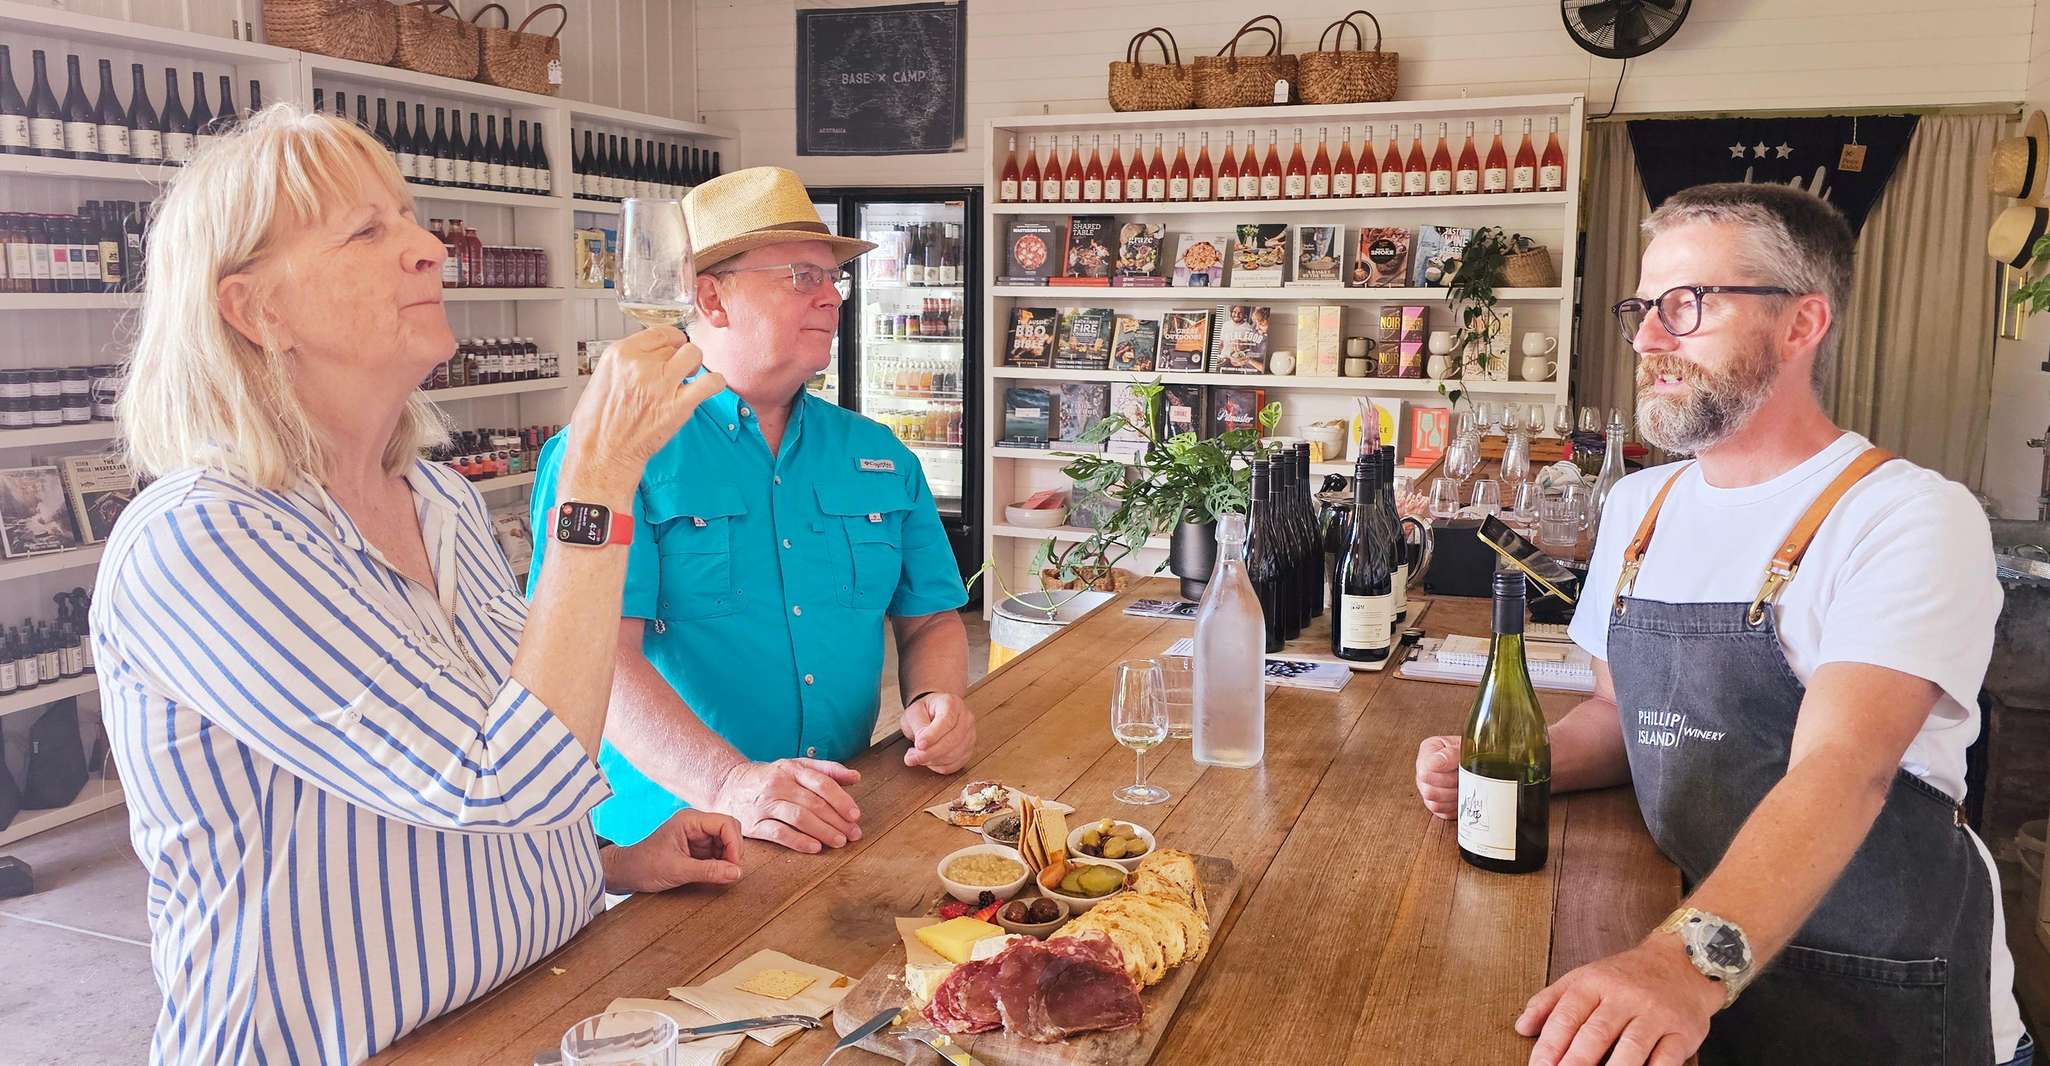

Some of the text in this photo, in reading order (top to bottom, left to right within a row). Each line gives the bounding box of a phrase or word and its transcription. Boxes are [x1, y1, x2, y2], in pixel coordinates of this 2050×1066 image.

[842, 73, 871, 84] BASE
[893, 70, 926, 83] CAMP
[1073, 324, 1098, 333] FIRE
[1380, 317, 1400, 330] NOIR
[1015, 325, 1046, 337] BBQ
[1379, 353, 1399, 364] NOIR
[587, 522, 597, 541] 4:47
[1638, 710, 1681, 728] PHILLIP
[1638, 730, 1675, 747] ISLAND
[1683, 727, 1727, 741] WINERY
